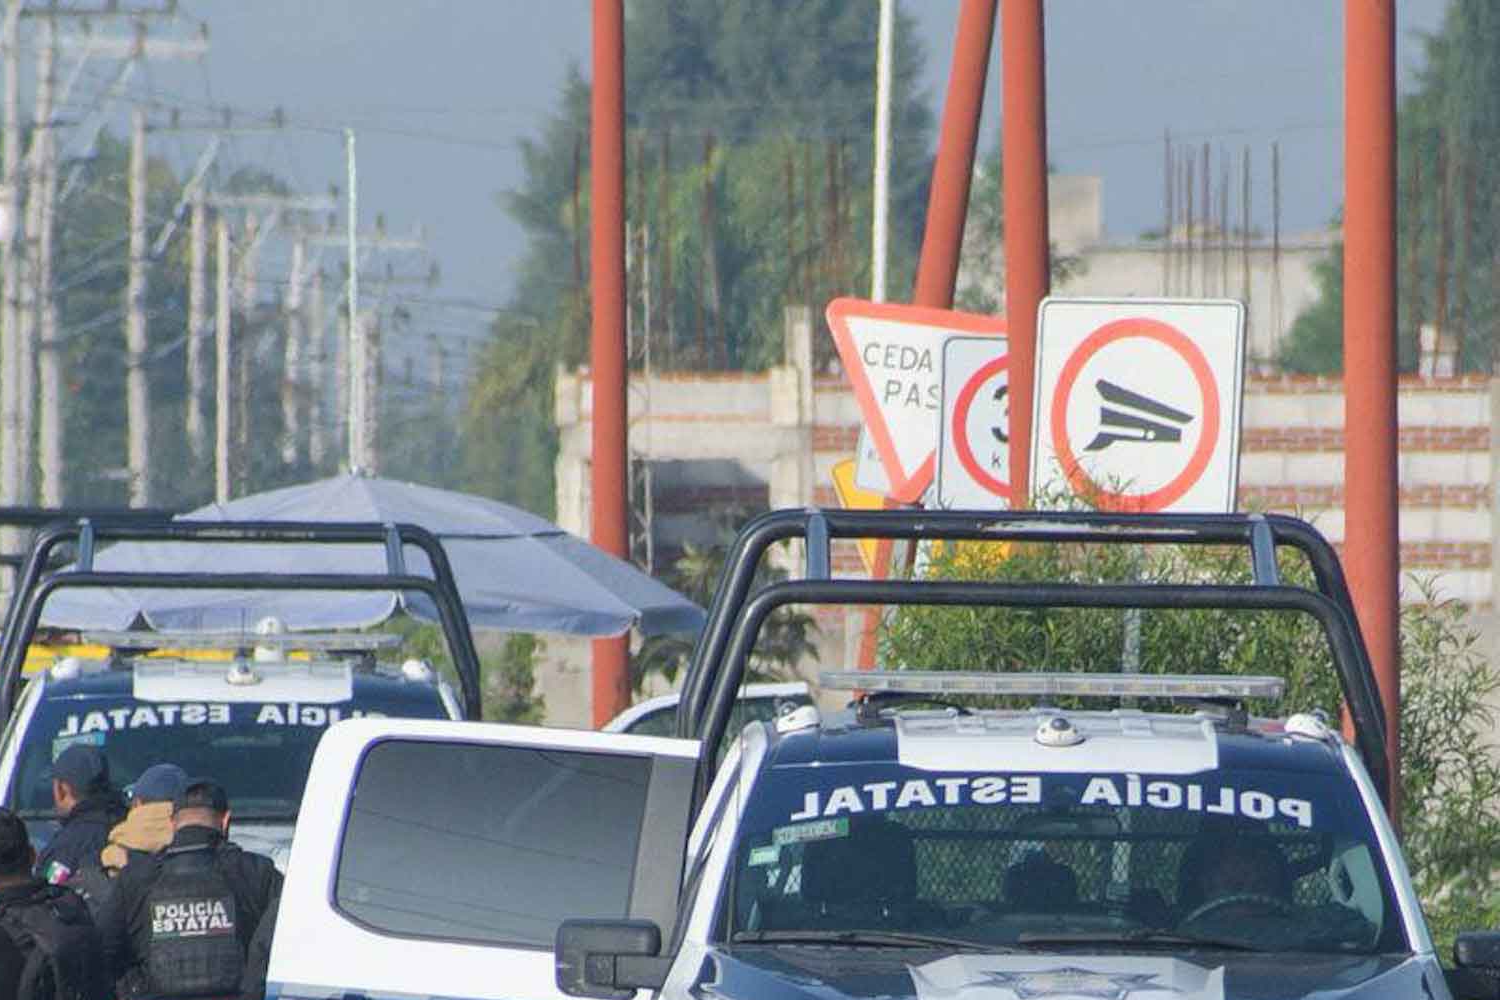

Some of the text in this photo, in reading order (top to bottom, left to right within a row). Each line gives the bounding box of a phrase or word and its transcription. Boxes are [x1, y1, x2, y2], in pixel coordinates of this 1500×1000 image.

[863, 342, 933, 373] CEDA
[883, 379, 941, 411] PAS
[152, 914, 234, 933] ESTATAL
